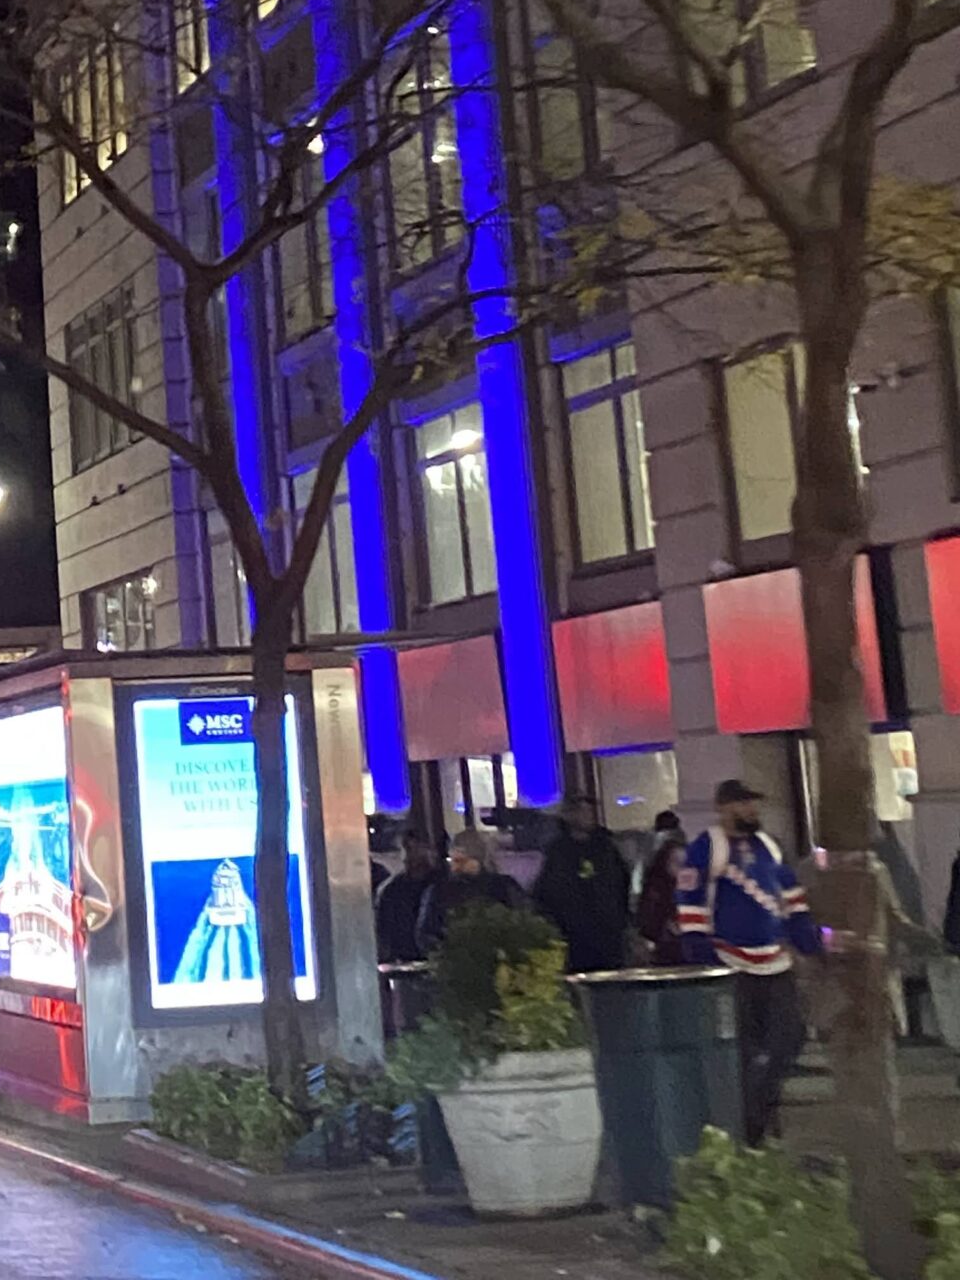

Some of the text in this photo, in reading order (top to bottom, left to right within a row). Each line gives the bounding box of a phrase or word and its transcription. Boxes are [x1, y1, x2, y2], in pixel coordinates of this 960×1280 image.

[206, 713, 244, 729] MSC
[175, 759, 251, 776] DISCOVE
[170, 777, 256, 795] THE WOR
